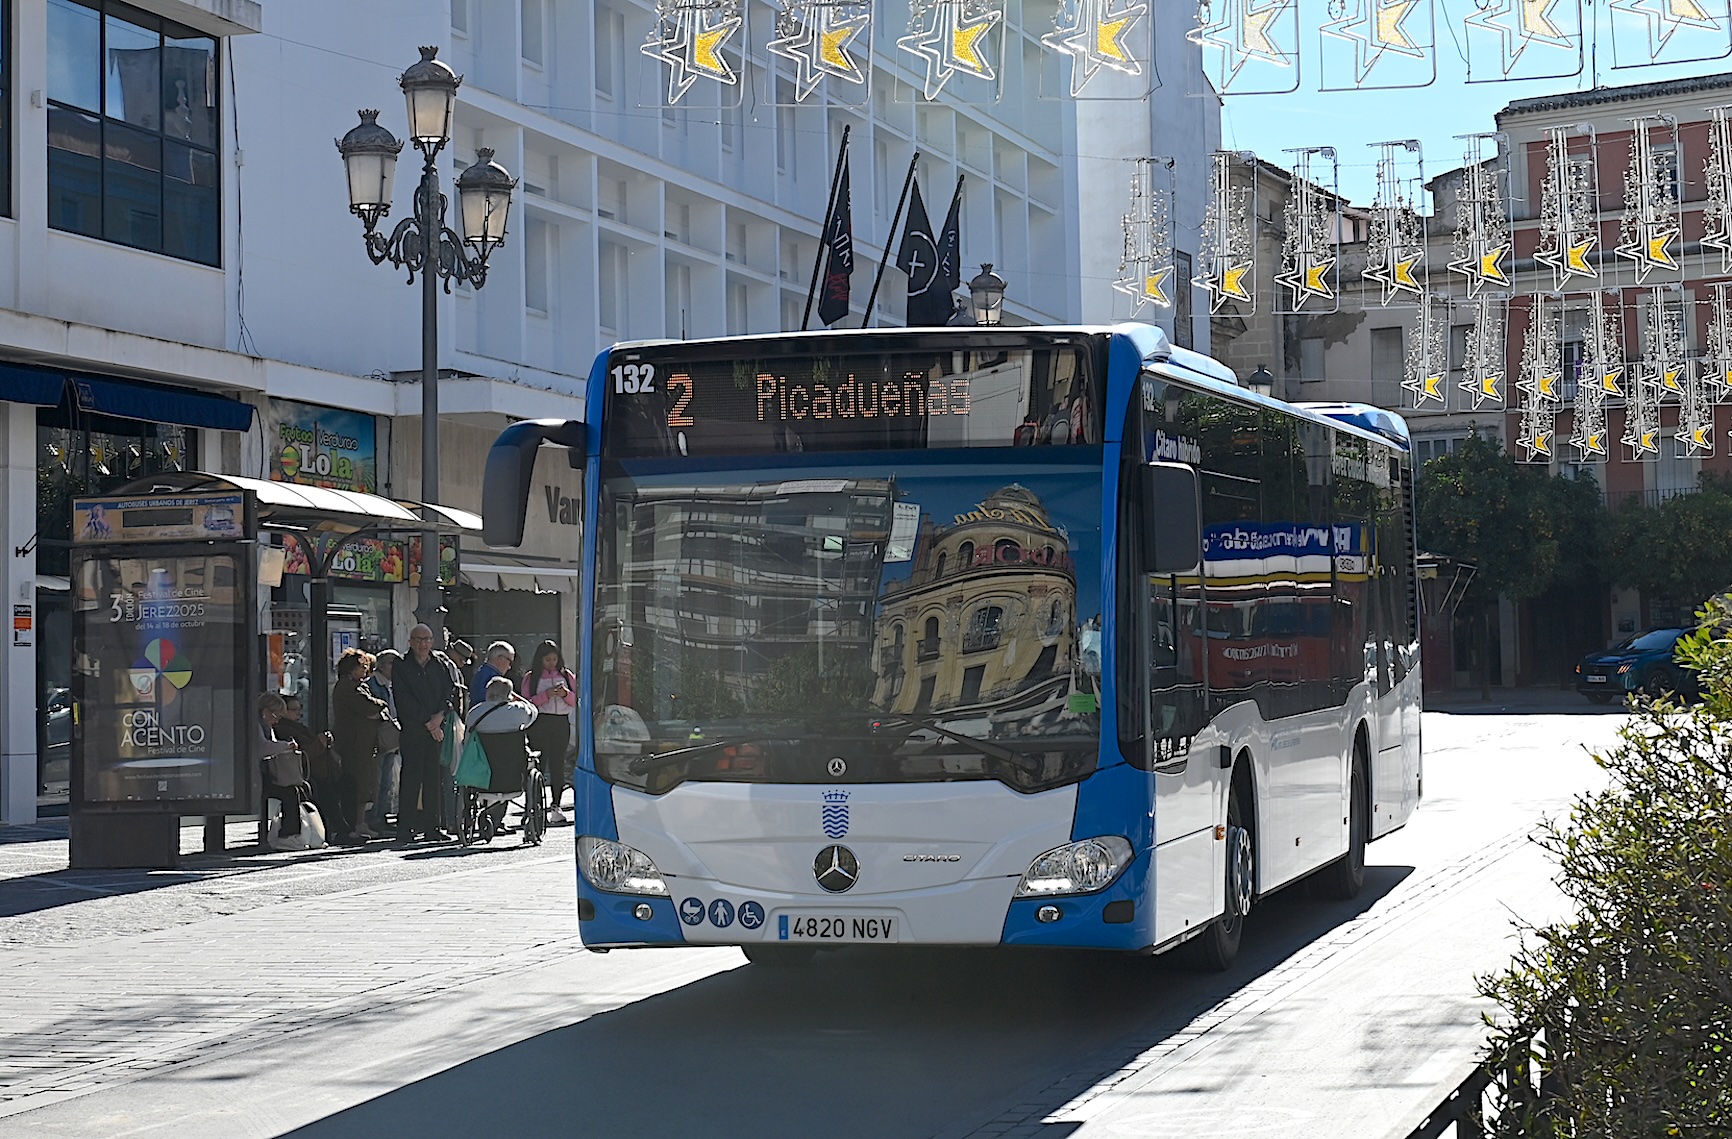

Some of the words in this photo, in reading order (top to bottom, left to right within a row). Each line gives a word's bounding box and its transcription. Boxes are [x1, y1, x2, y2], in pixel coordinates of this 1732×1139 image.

[610, 363, 655, 394] 132
[666, 373, 694, 428] 2
[755, 371, 971, 421] Picadueñas
[279, 423, 314, 443] Frutas
[318, 430, 359, 451] Verduras
[1155, 429, 1178, 460] Citaro
[299, 444, 353, 480] Lola
[117, 501, 148, 509] AUTOBUSES
[149, 500, 175, 508] URBANOS
[331, 552, 374, 573] Lola
[138, 590, 171, 599] Festival
[172, 589, 183, 598] de
[184, 588, 204, 597] Cine
[122, 710, 160, 728] CON
[120, 725, 205, 747] ACENTO
[147, 746, 175, 755] Festival
[176, 745, 187, 753] de
[188, 744, 205, 753] Cine
[902, 854, 962, 863] CITARO
[793, 917, 846, 939] 4820
[852, 918, 893, 939] NGV
